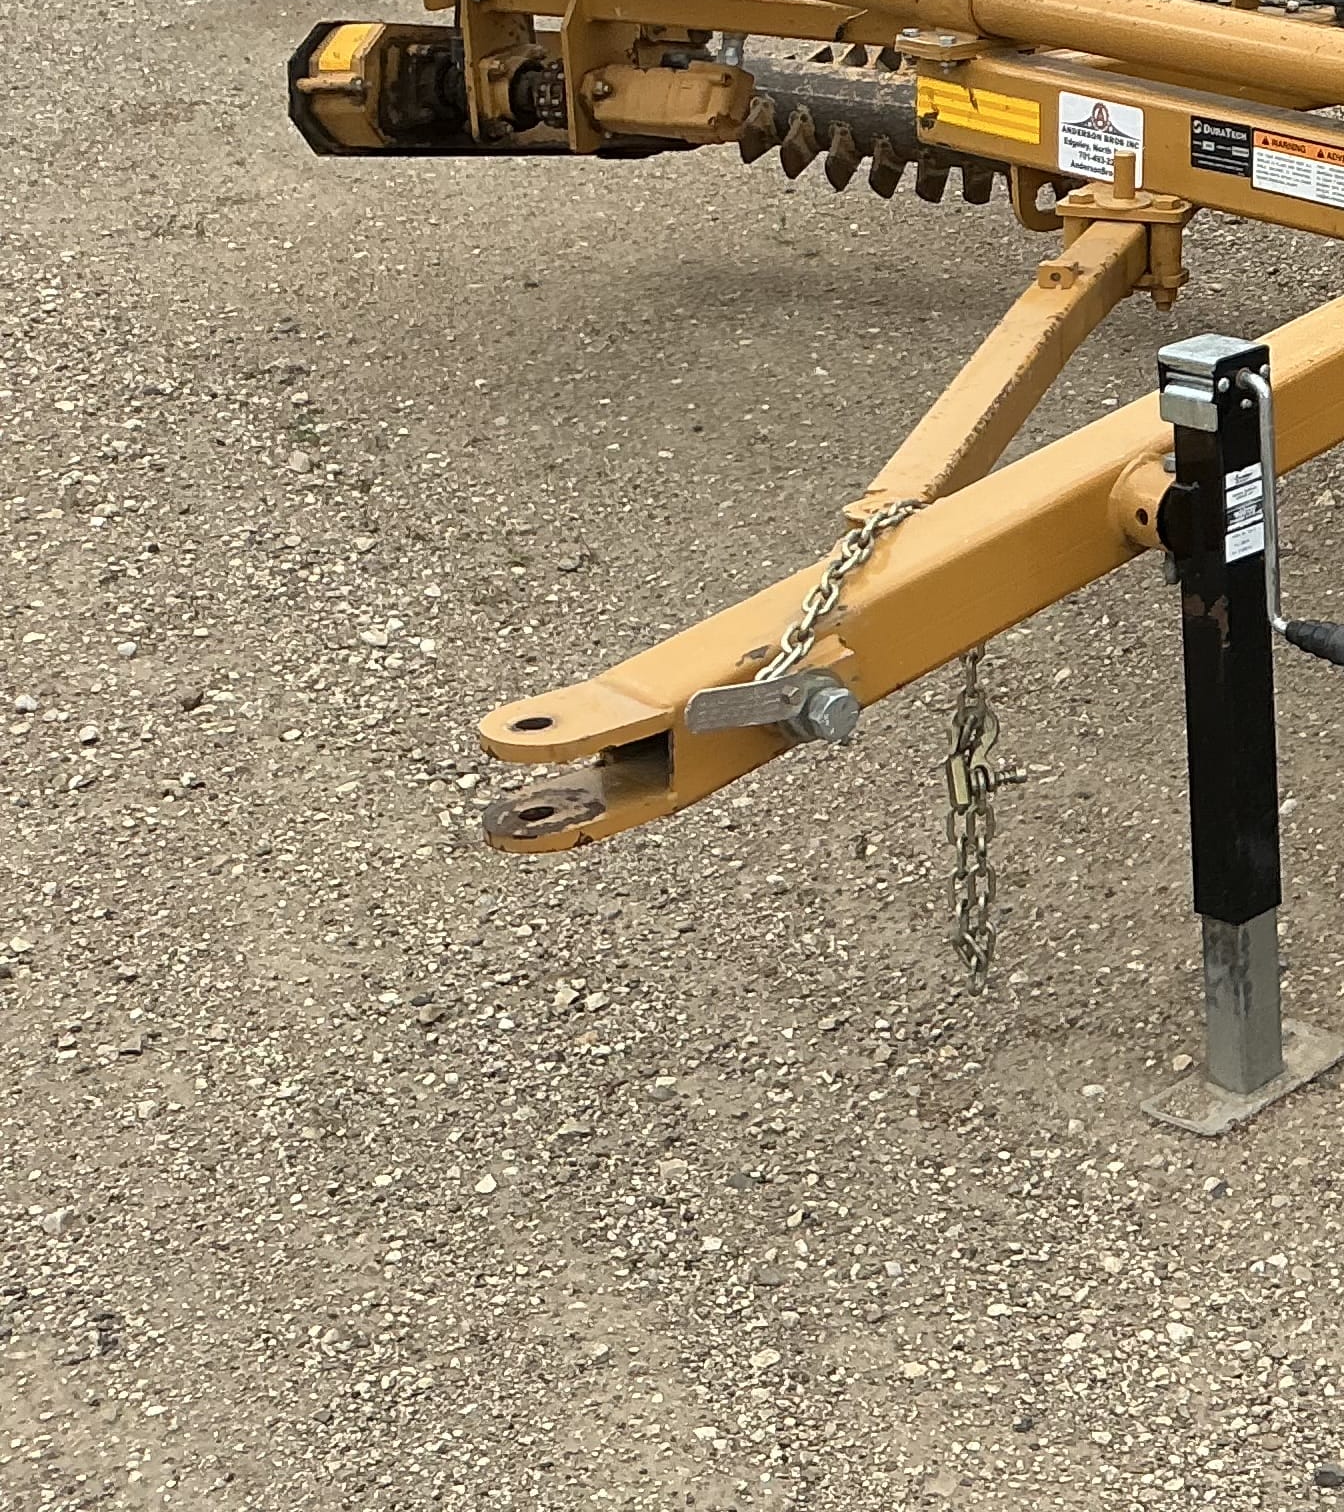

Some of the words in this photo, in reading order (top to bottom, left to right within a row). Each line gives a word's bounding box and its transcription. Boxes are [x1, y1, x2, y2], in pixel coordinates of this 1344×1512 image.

[1062, 125, 1102, 141] ANDERSON
[1103, 134, 1125, 146] BROS
[1126, 140, 1140, 149] INC
[1271, 138, 1307, 154] WARNING
